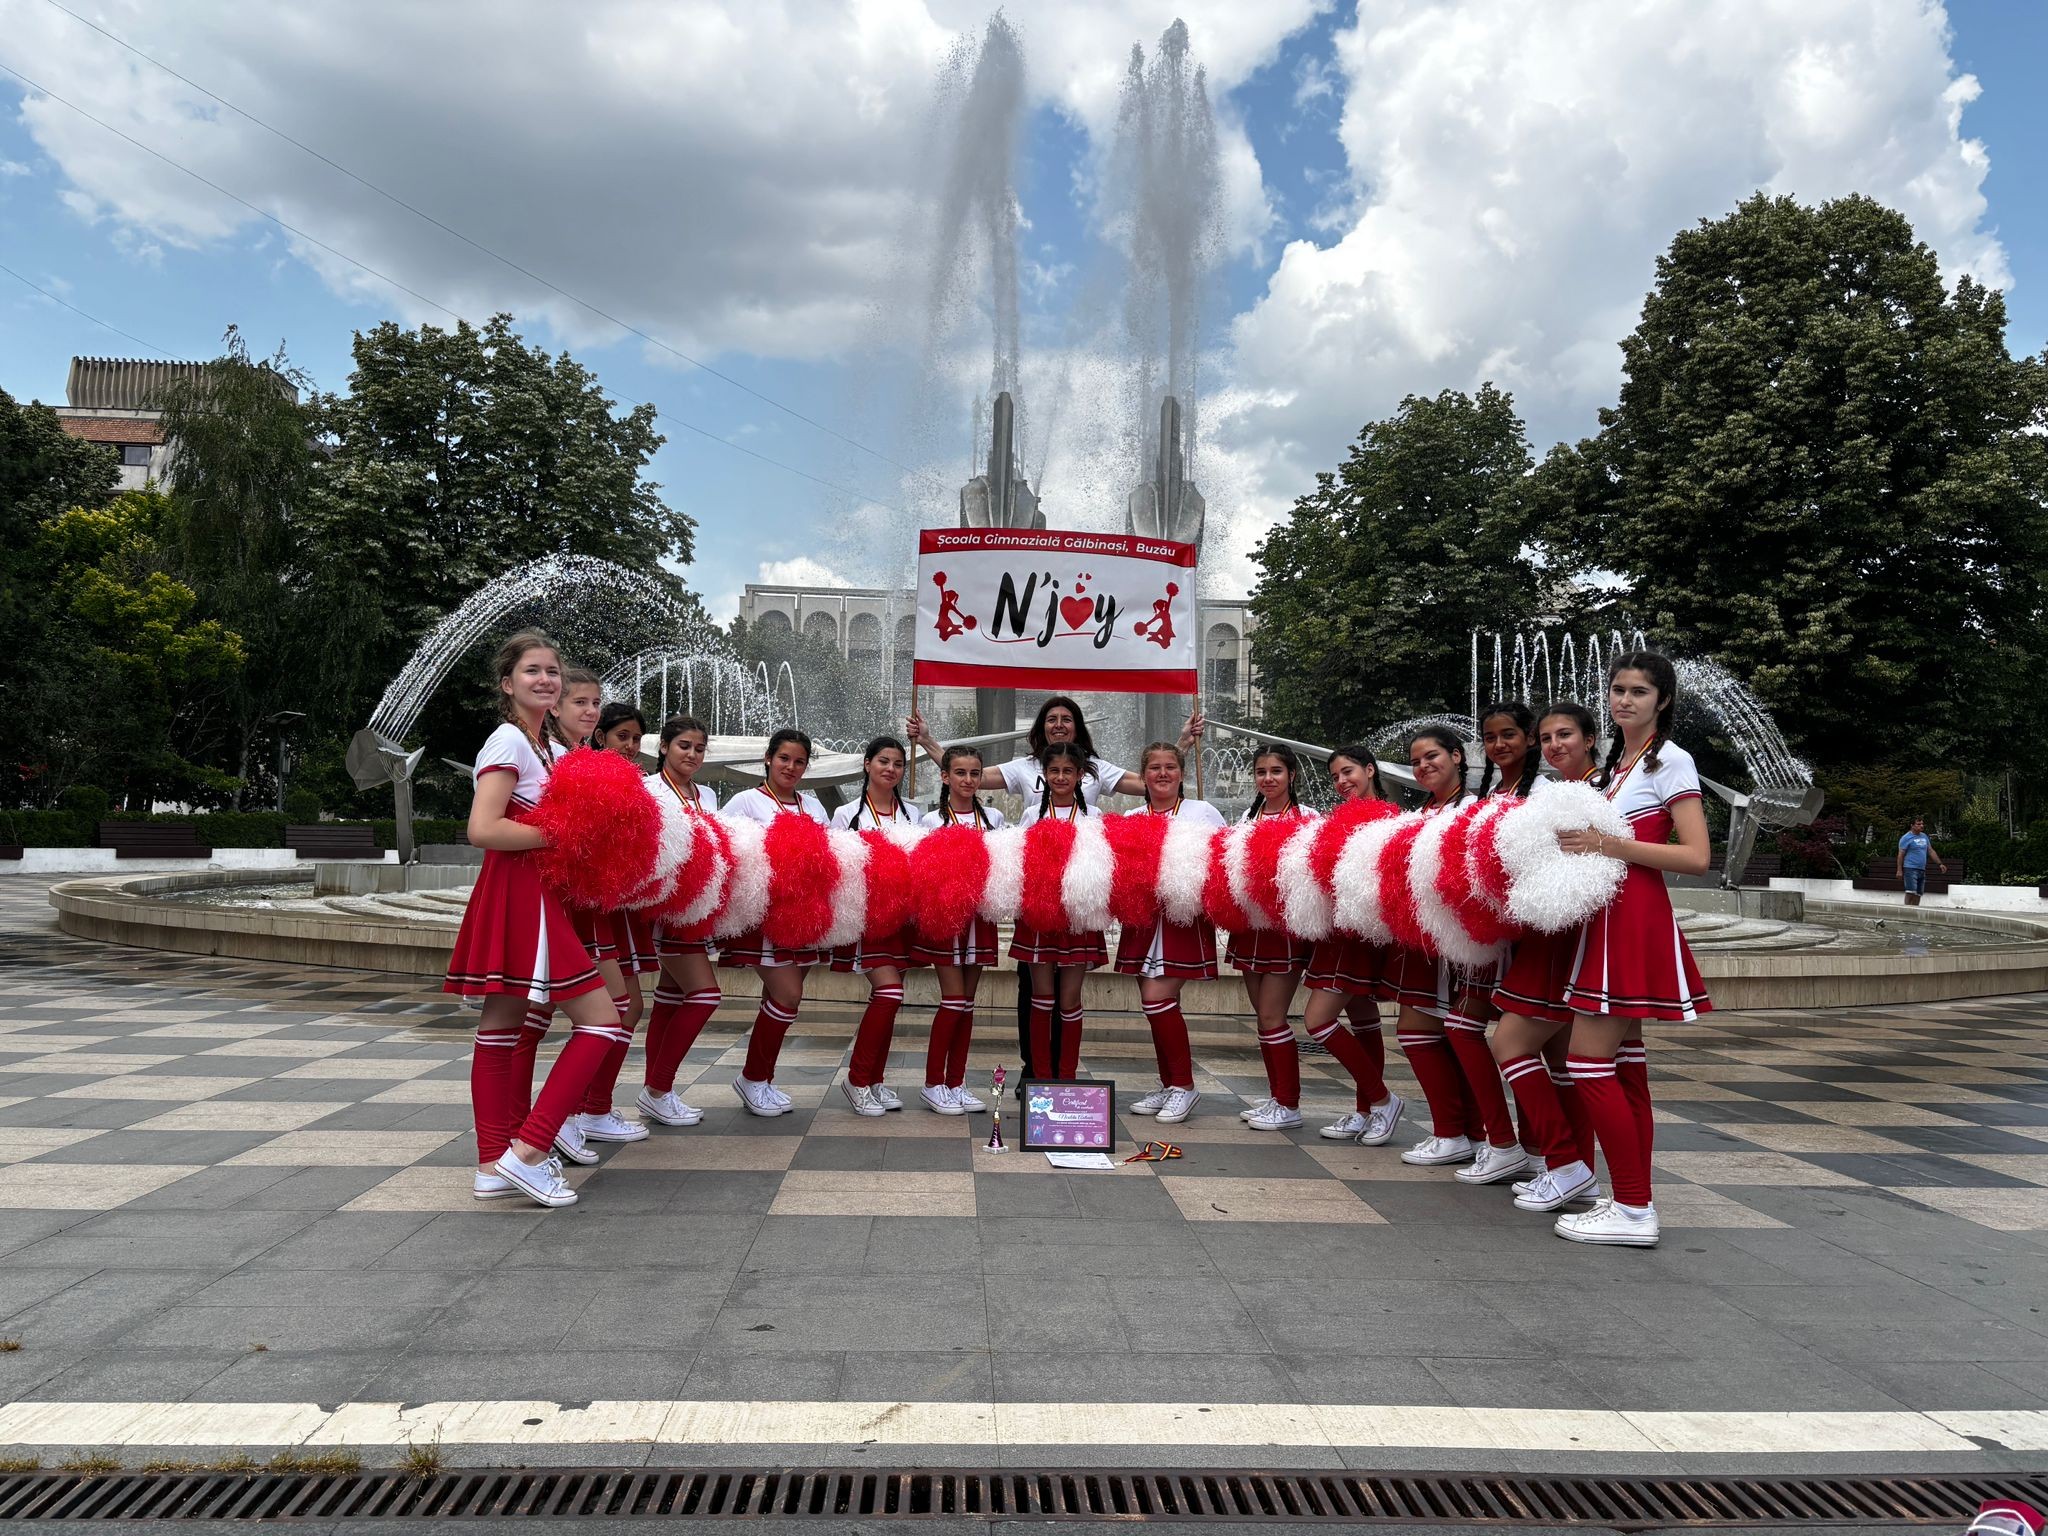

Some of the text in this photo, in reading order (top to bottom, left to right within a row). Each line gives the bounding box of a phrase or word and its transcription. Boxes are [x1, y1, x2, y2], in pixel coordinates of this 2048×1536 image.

[937, 534, 1176, 557] Școala Gimnazială Gălbinași, Buzău
